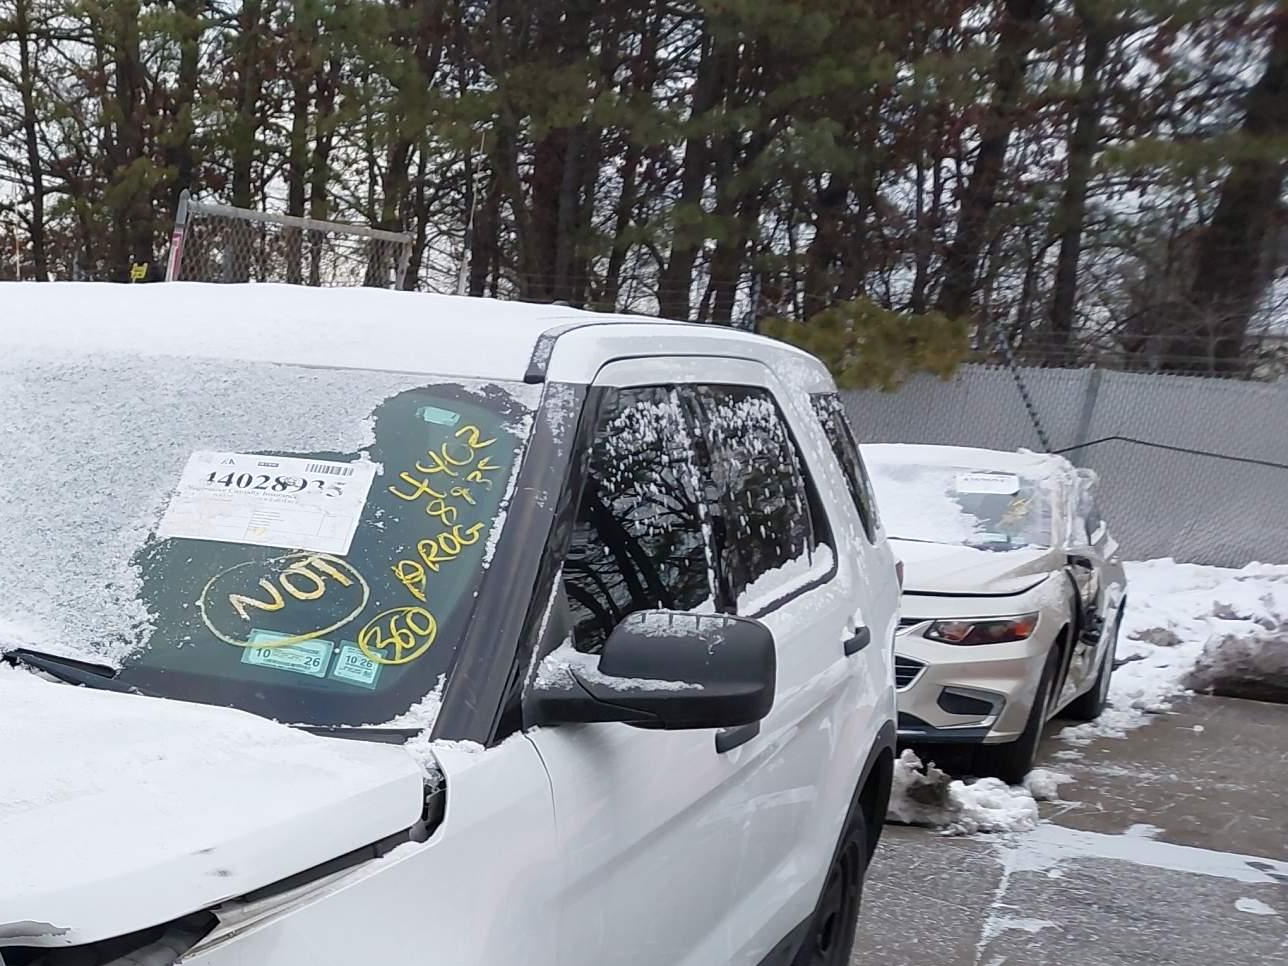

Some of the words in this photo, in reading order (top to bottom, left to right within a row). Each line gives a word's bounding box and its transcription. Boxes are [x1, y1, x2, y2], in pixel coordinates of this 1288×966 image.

[361, 606, 434, 661] 360
[255, 647, 271, 660] 10
[303, 656, 321, 668] 26
[344, 654, 358, 665] 10
[359, 657, 374, 669] 26
